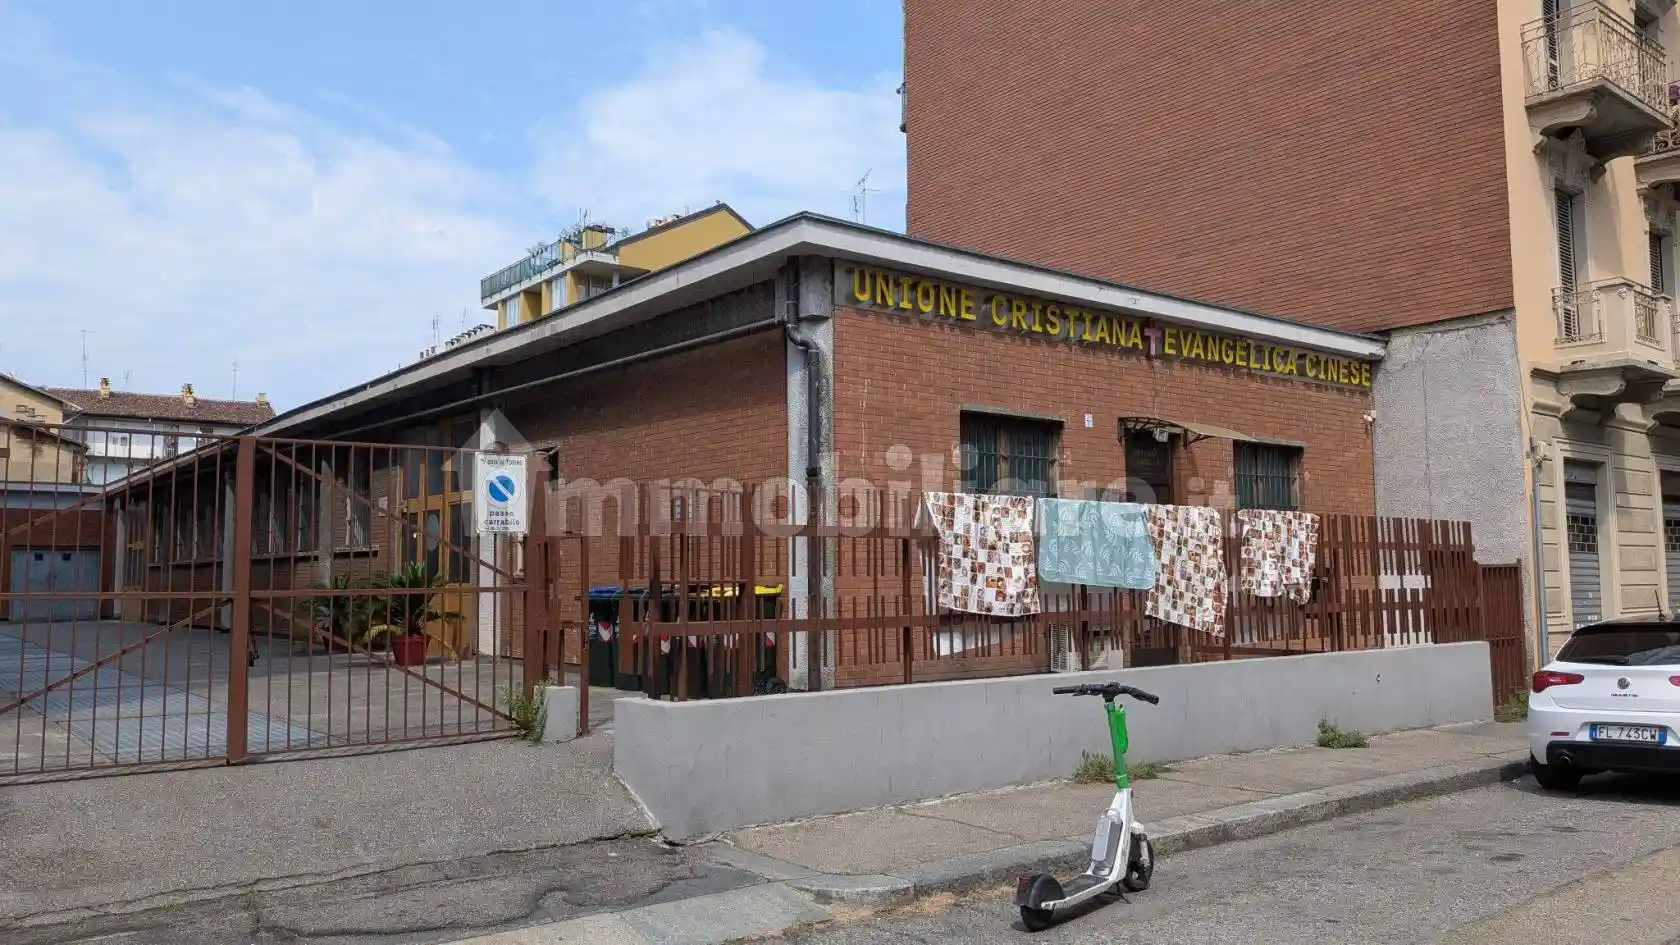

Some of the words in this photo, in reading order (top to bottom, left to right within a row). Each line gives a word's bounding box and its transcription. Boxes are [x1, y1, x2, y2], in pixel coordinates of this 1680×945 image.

[853, 267, 977, 321] UNIONE
[991, 294, 1143, 350] CRISTIANA
[1164, 327, 1297, 376] EVANGELICA
[1305, 353, 1371, 388] CINESE
